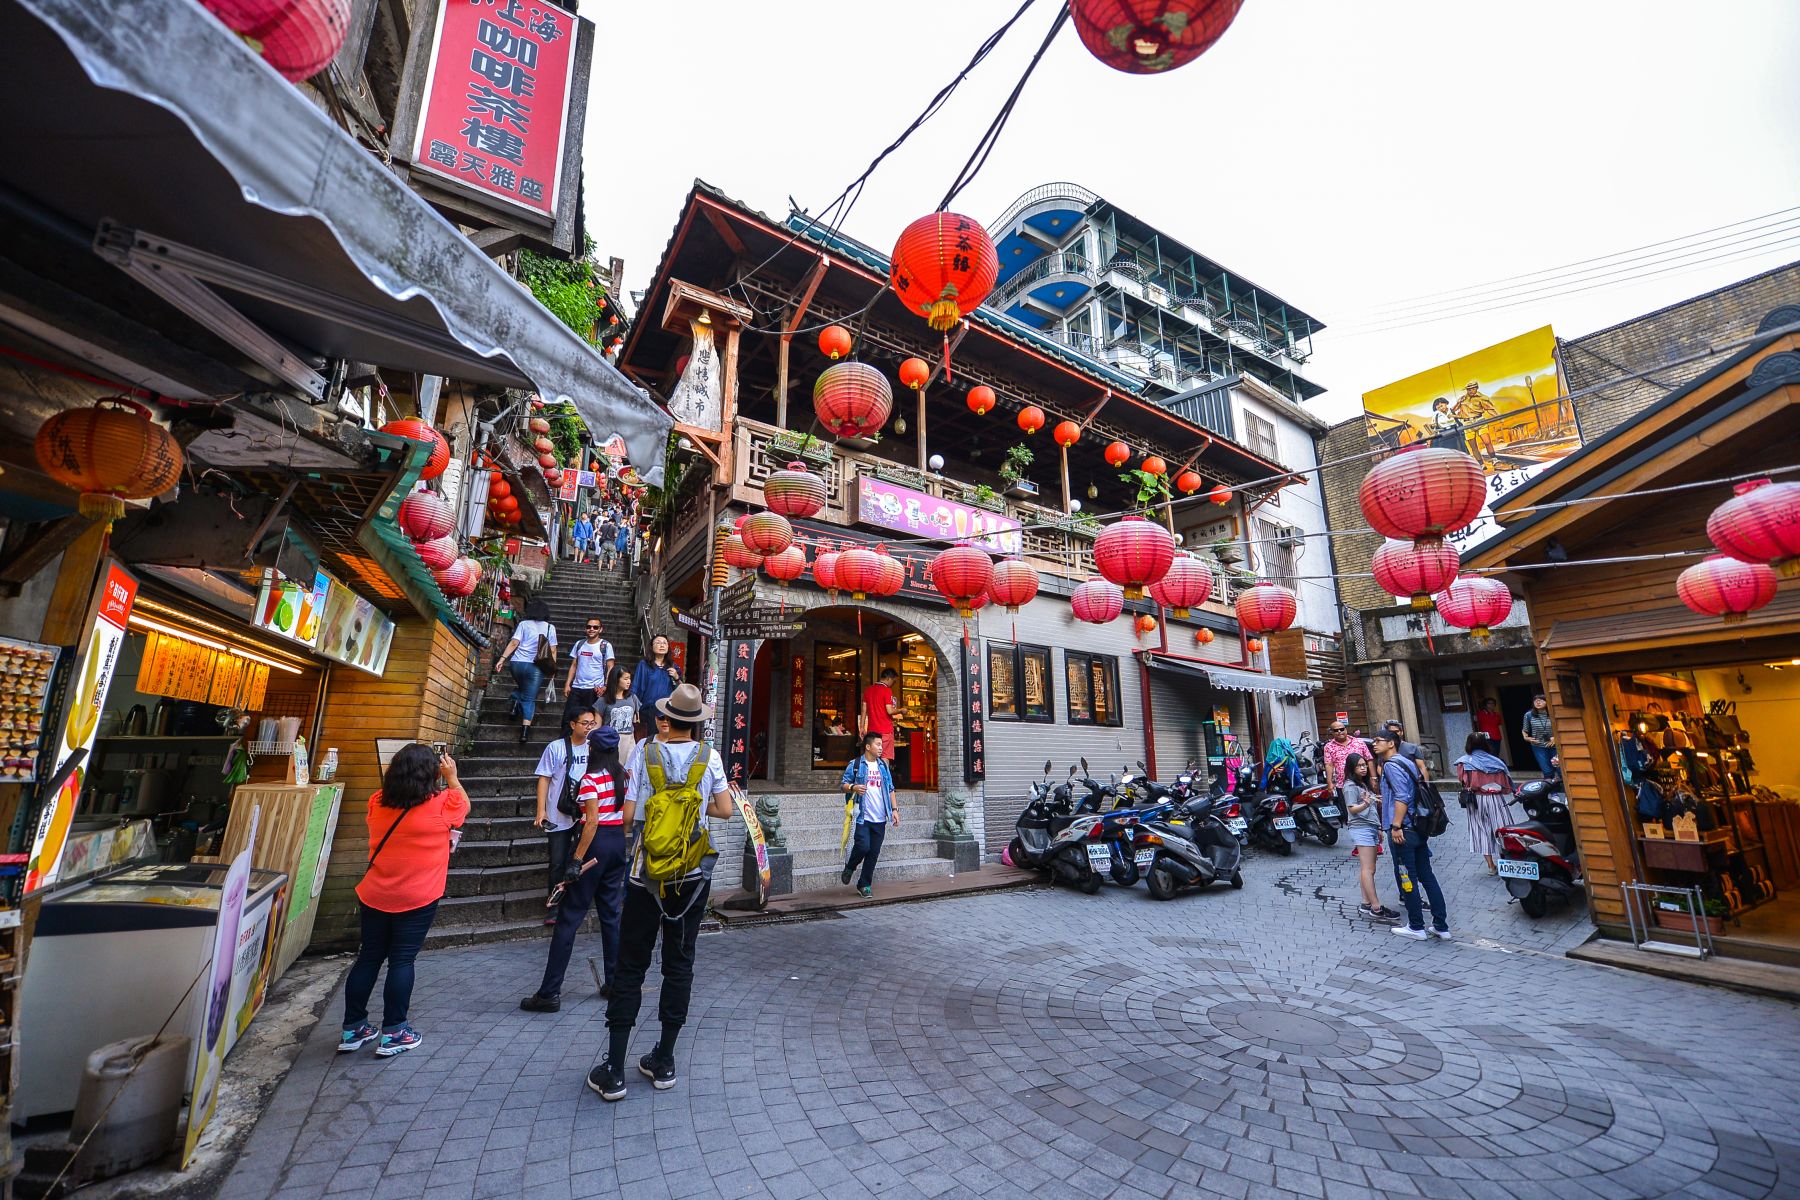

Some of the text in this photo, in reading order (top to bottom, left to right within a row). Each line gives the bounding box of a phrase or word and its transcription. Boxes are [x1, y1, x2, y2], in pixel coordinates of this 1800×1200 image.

[468, 0, 563, 43] 上海
[460, 18, 539, 167] 咖啡茶樓
[428, 139, 545, 202] 露天雅座
[695, 349, 711, 418] 悲情城市
[910, 580, 928, 590] Since
[1500, 864, 1538, 876] ADR-2950
